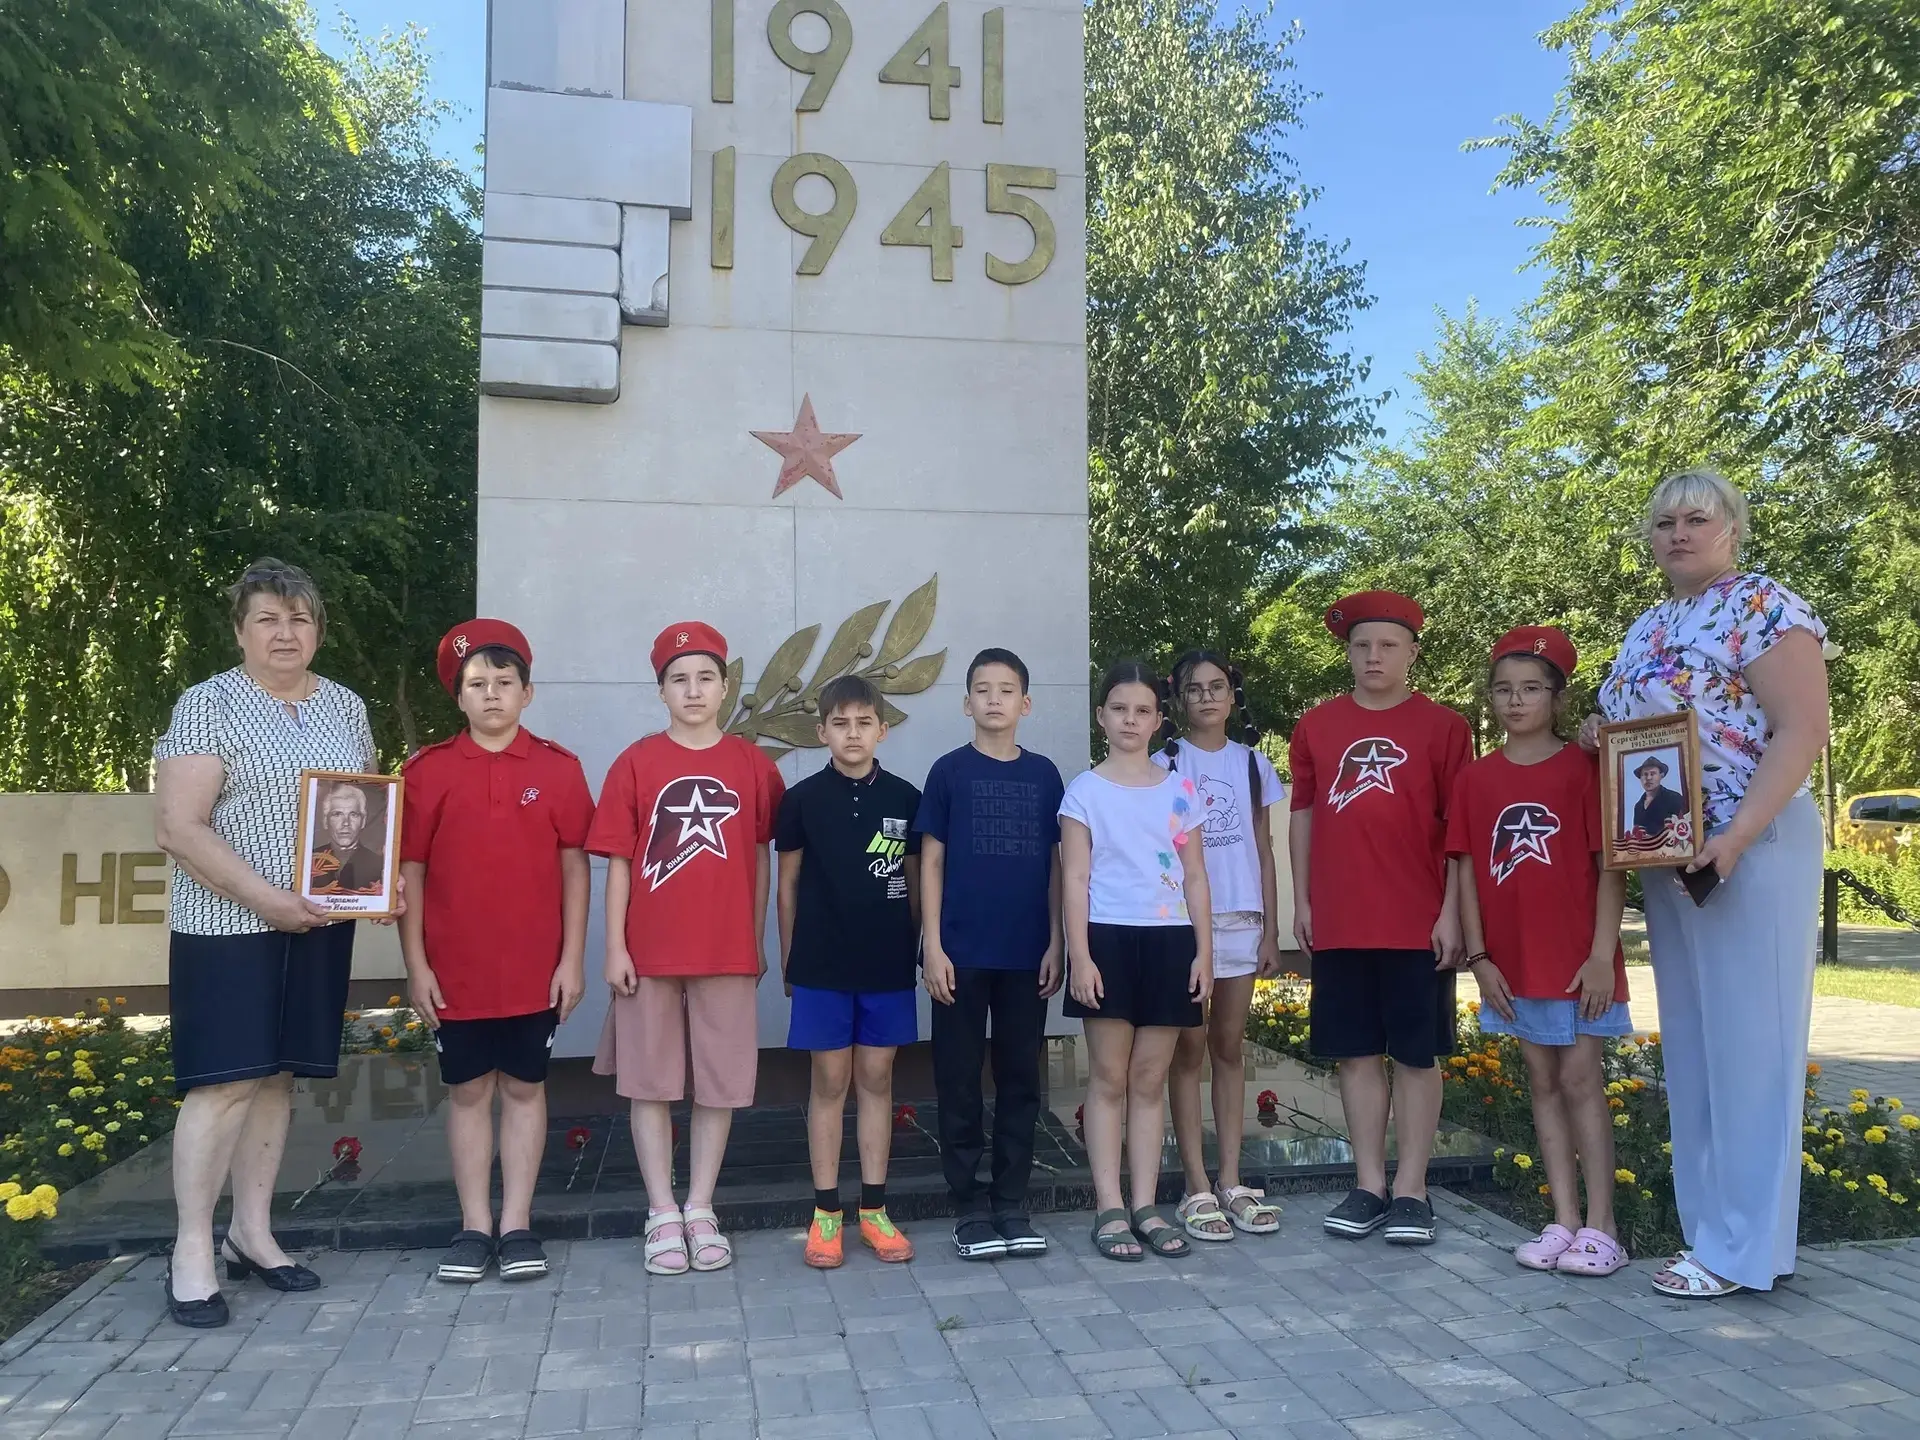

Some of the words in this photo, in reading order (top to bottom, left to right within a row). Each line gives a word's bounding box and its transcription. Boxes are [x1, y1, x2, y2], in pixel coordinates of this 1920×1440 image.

[711, 0, 1004, 125] 1941
[711, 146, 1057, 285] 1945
[972, 781, 1040, 798] ATHLETIC
[972, 799, 1040, 817] ATHLETIC
[972, 818, 1040, 836] ATHLETIC
[666, 841, 700, 871] ЮНАРМИЯ
[972, 838, 1040, 856] ATHLETIC
[60, 852, 167, 926] НЕ
